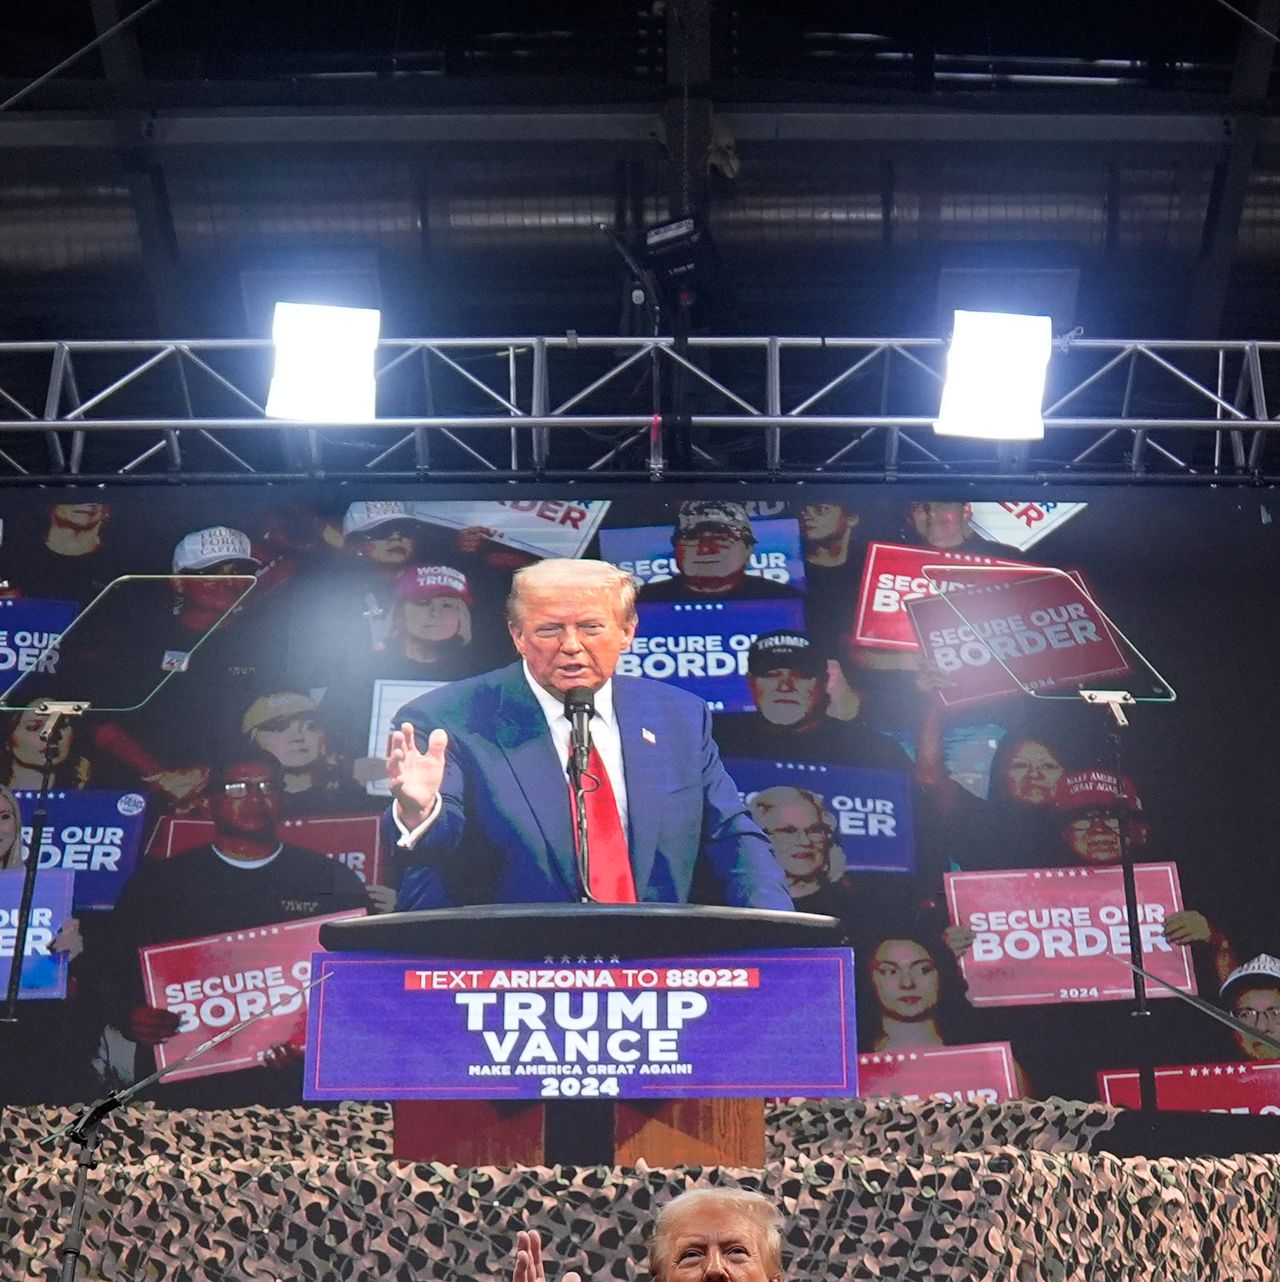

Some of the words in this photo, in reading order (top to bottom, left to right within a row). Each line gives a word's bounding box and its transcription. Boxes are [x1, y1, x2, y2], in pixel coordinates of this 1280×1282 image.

[508, 500, 587, 530] DER
[750, 552, 787, 569] UR
[928, 614, 1027, 648] SECURE
[1030, 602, 1089, 627] OUR
[14, 631, 62, 650] OUR
[934, 618, 1102, 673] BORDER
[614, 651, 750, 679] BORD
[831, 795, 895, 815] OUR
[61, 826, 124, 845] OUR
[36, 843, 122, 872] DER
[969, 906, 1092, 932] SECURE
[971, 923, 1173, 962] BORDER
[165, 966, 286, 1004] SECURE
[415, 970, 484, 989] TEXT
[489, 969, 616, 989] ARIZONA
[621, 969, 659, 989] TO
[665, 968, 749, 988] 88022
[1059, 987, 1099, 999] 2024
[167, 982, 312, 1033] BORD
[455, 991, 708, 1031] TRUMP
[482, 1029, 679, 1063] VANCE
[468, 1065, 511, 1076] MAKE
[515, 1064, 583, 1076] AMERICA
[587, 1064, 635, 1076] GREAT
[639, 1063, 693, 1075] AGAIN!
[540, 1077, 620, 1097] 2024
